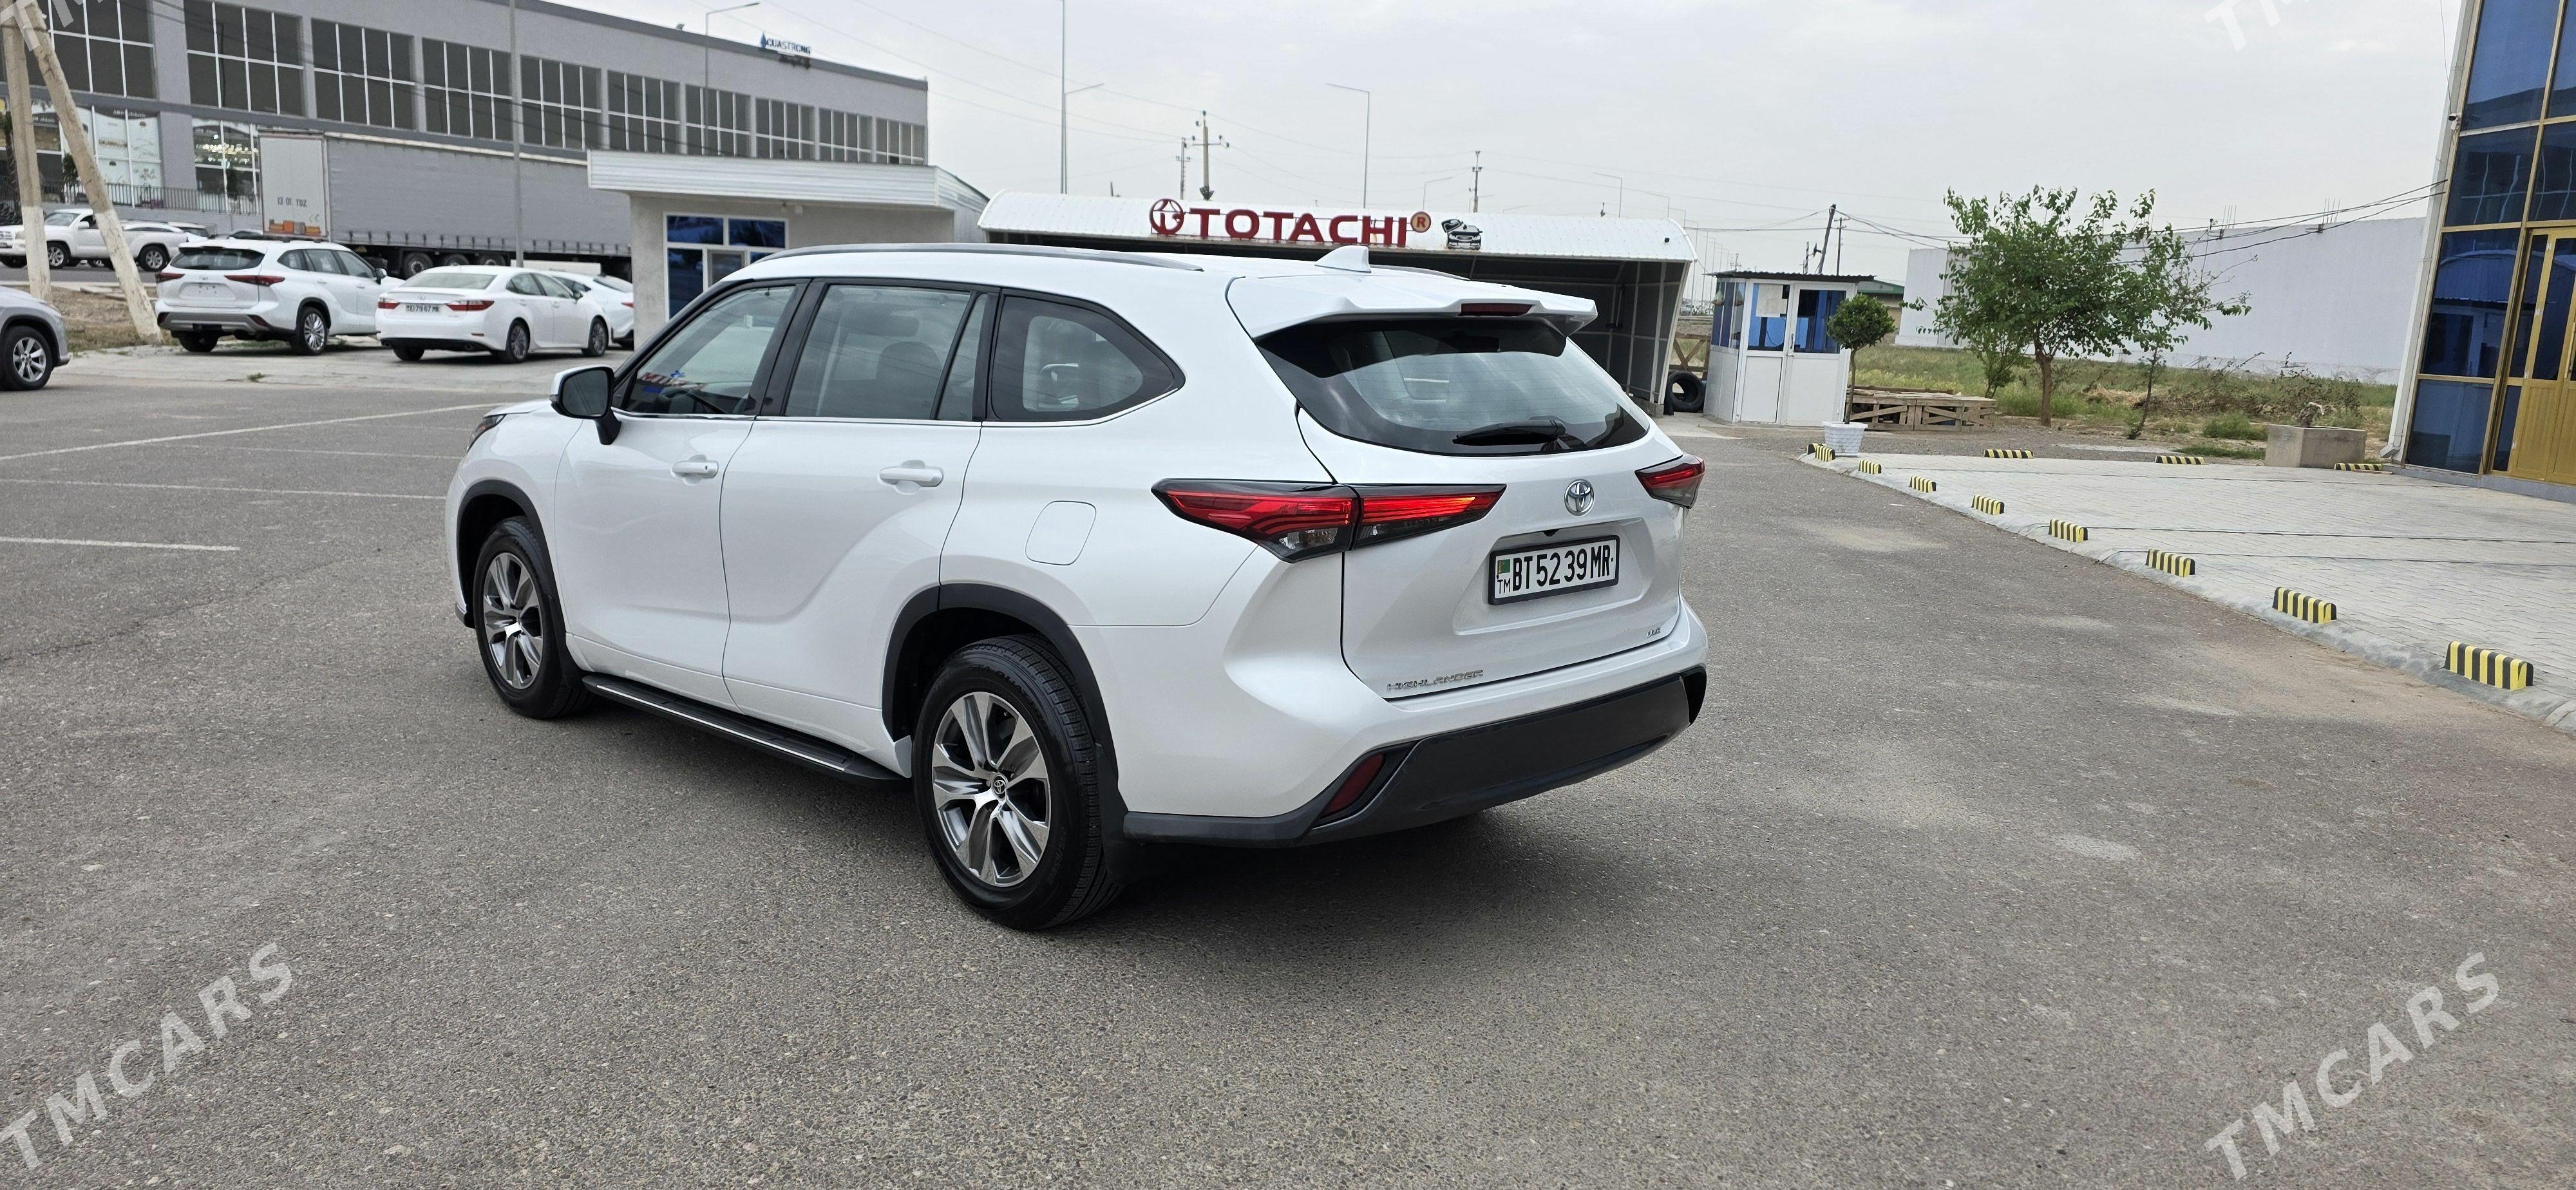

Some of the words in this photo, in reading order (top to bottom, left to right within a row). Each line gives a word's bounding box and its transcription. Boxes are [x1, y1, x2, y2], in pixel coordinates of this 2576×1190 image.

[1189, 208, 1407, 247] TOTACHI
[1497, 578, 1511, 594] TM
[1387, 669, 1484, 691] HIGHLANDER
